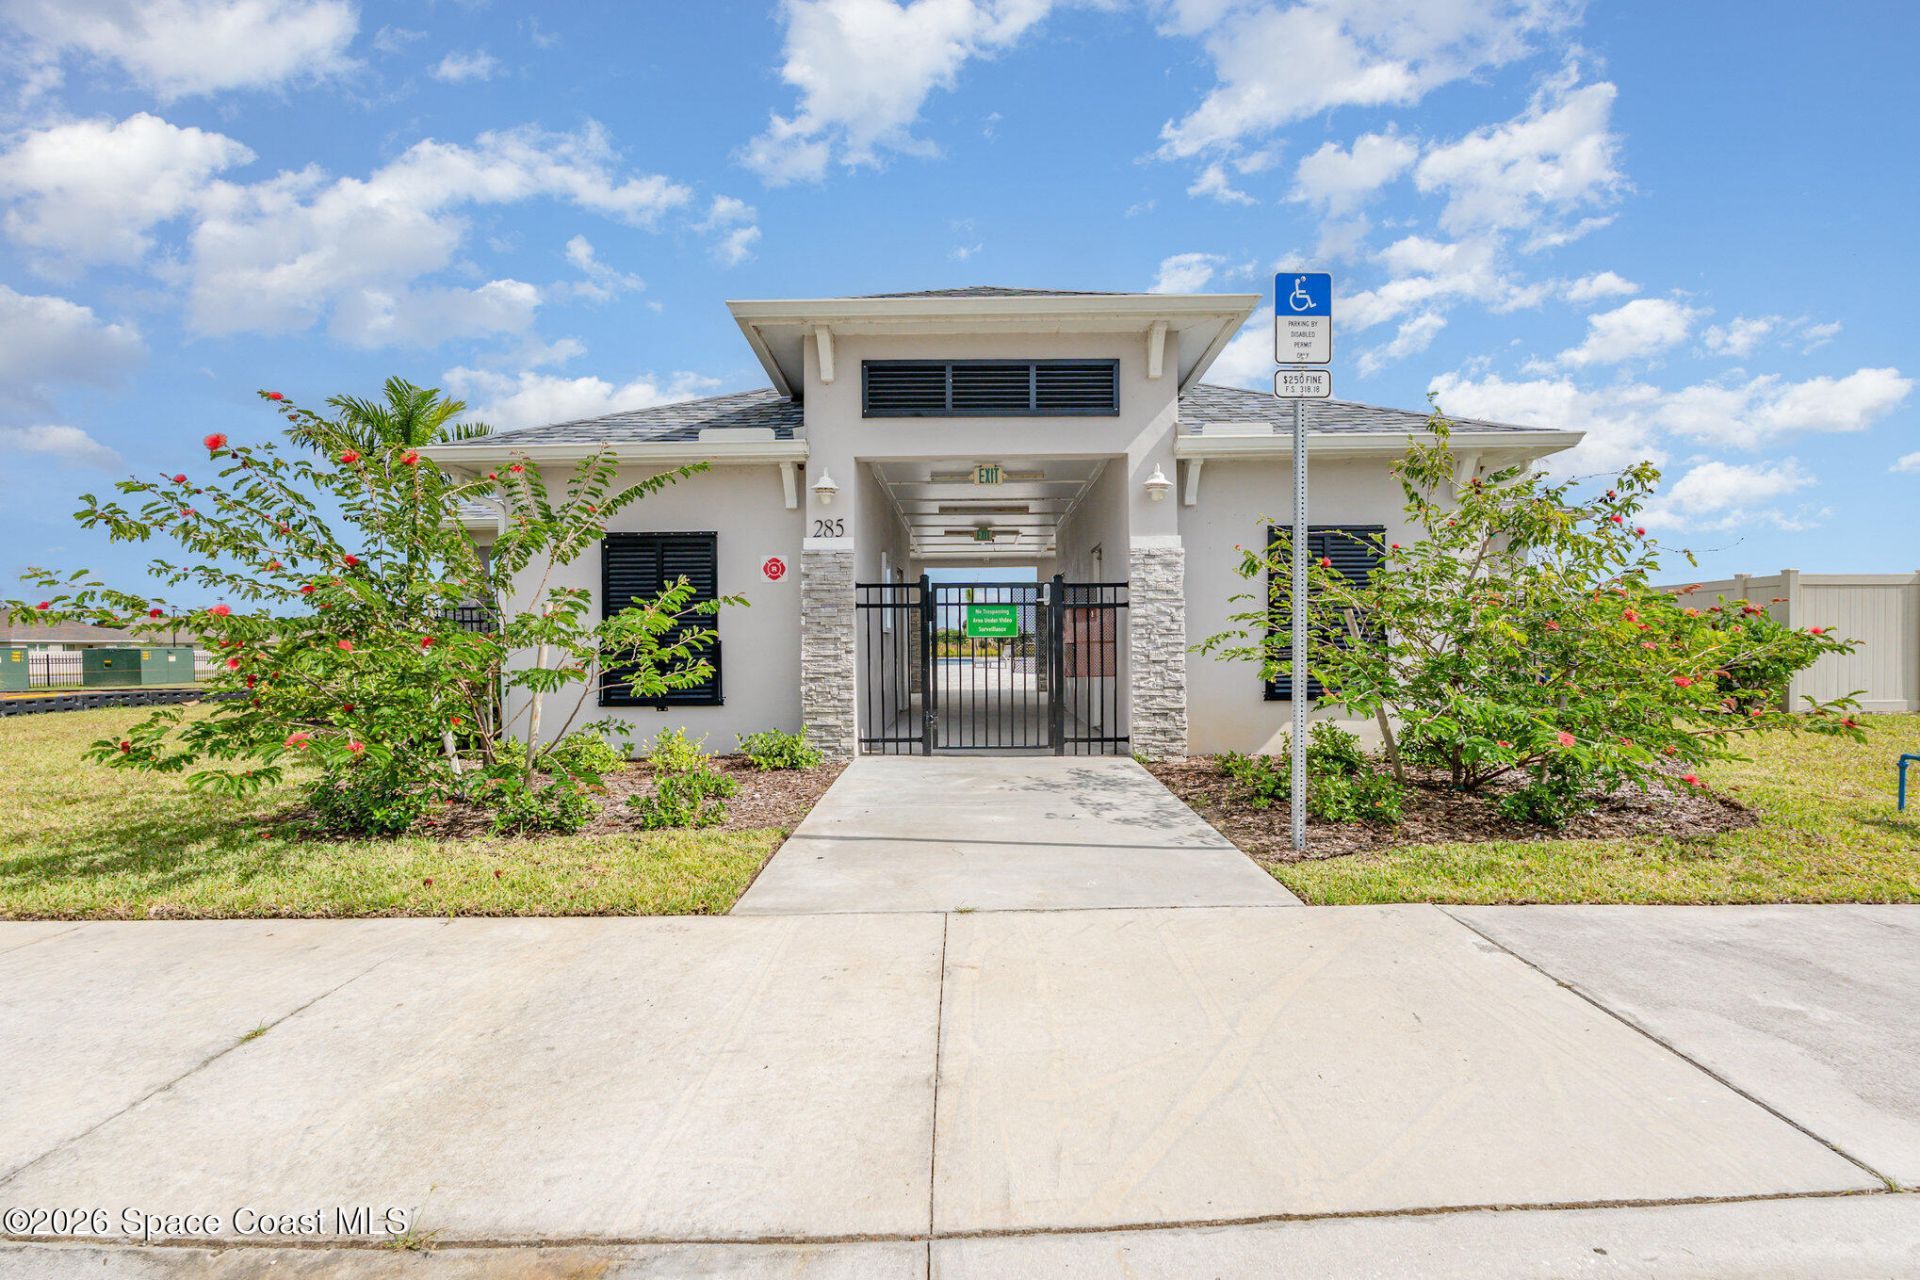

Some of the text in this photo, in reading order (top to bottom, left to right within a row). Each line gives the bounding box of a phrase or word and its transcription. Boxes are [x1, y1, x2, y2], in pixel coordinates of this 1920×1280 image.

[1283, 375, 1322, 384] $250 FINE
[979, 467, 999, 484] EXIT
[813, 518, 844, 538] 285
[976, 530, 991, 540] EXIT
